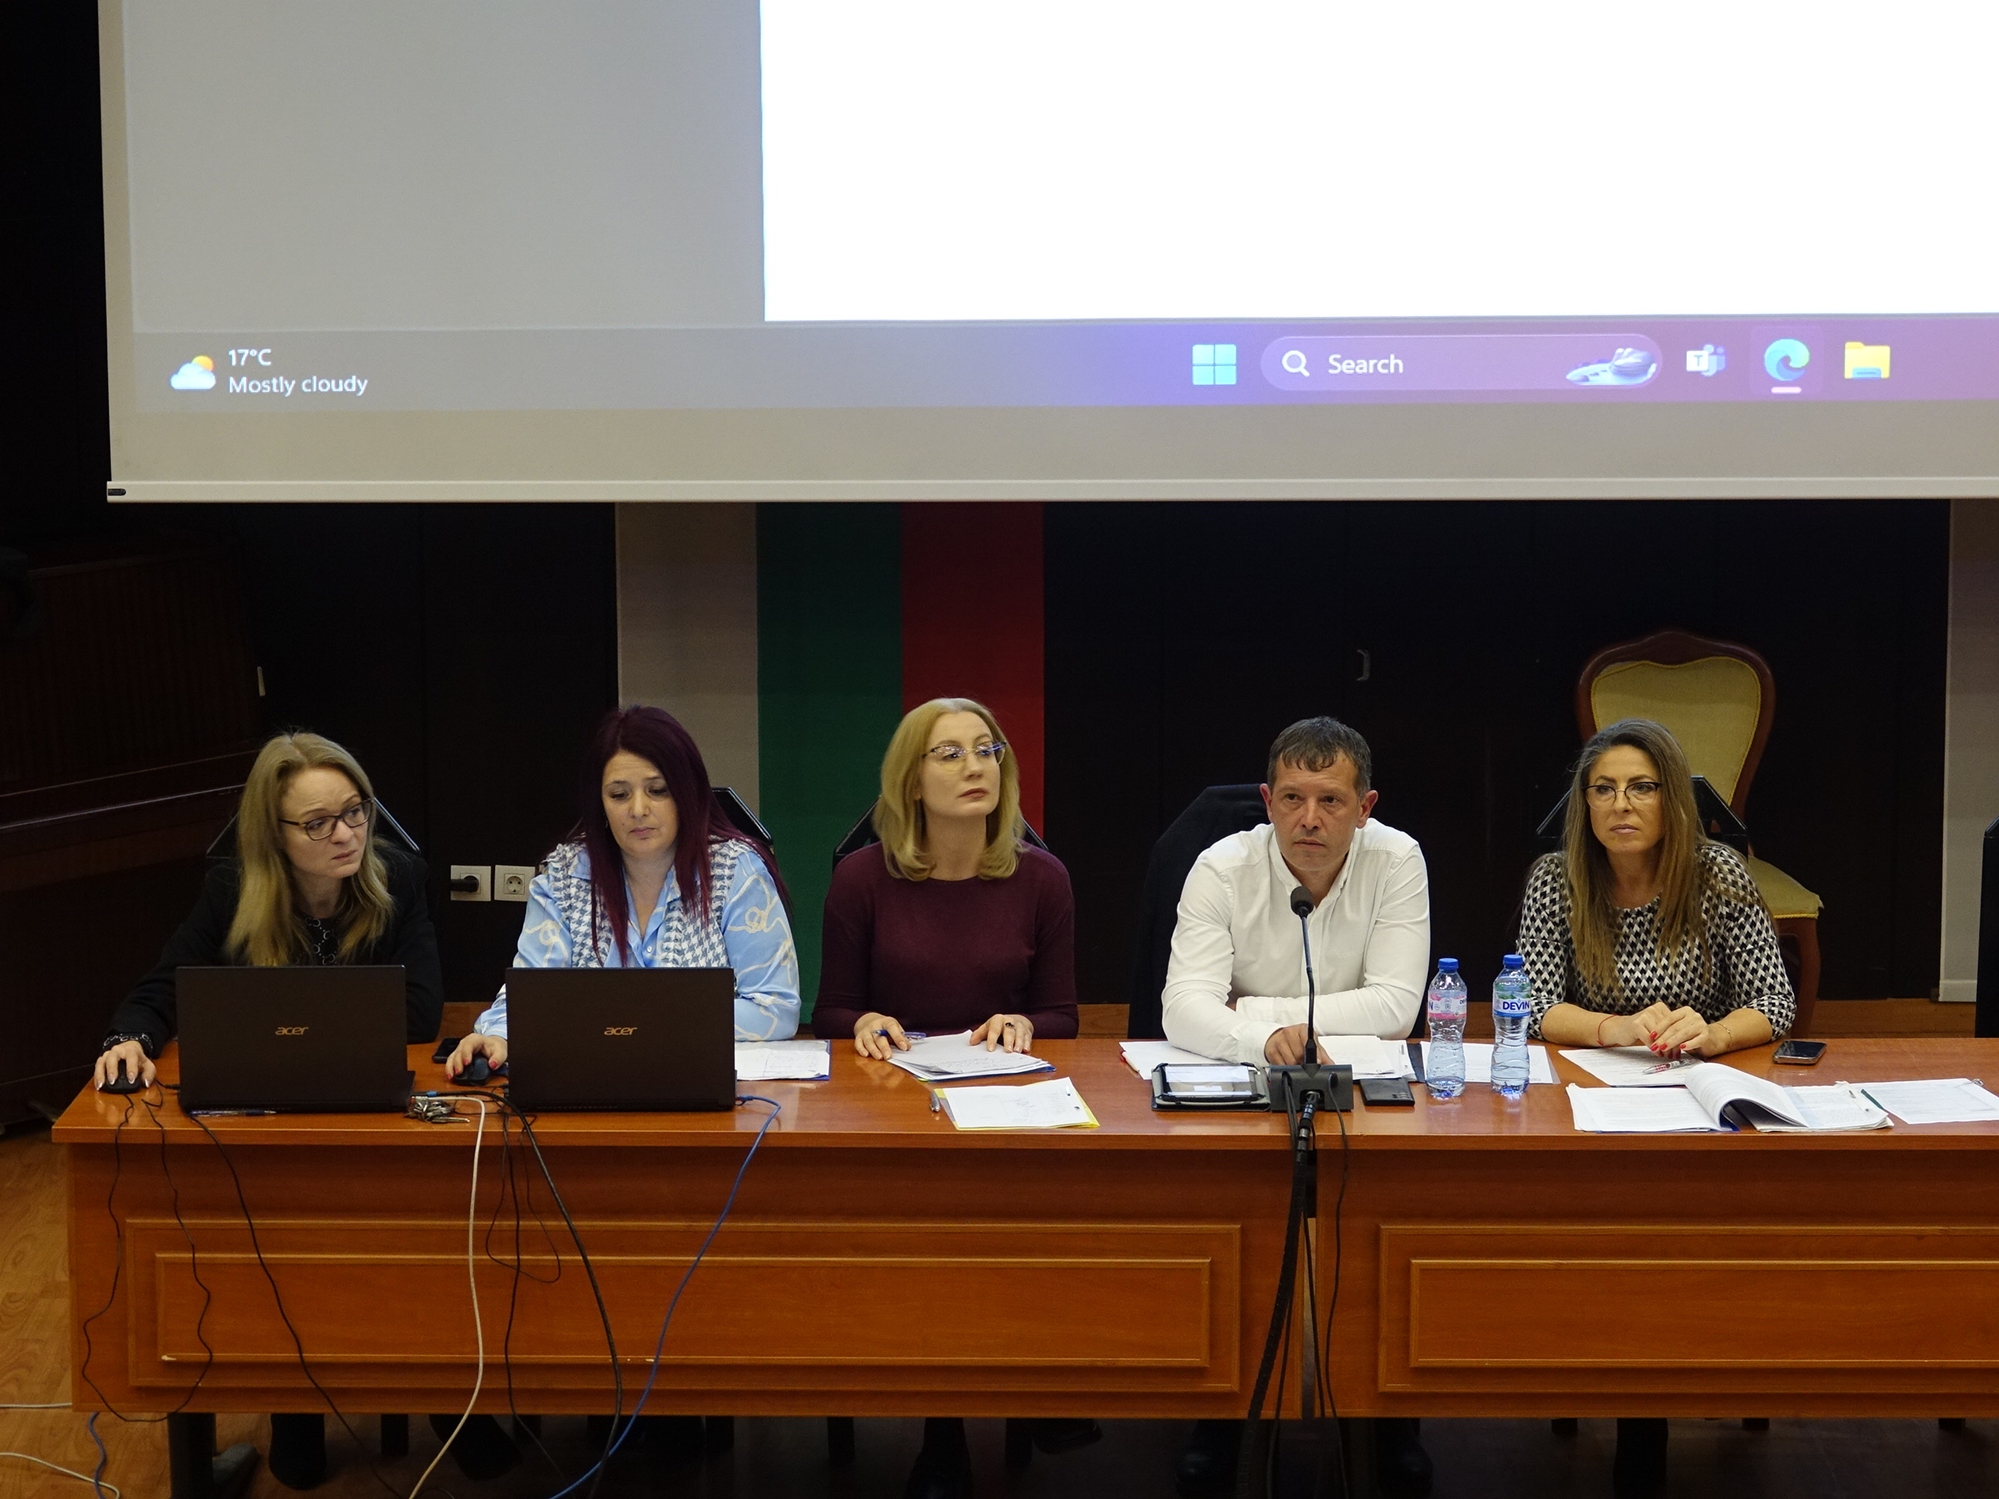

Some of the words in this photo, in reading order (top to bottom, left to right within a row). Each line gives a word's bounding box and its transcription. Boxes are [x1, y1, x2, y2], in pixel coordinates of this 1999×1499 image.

[228, 348, 272, 367] 17°C
[1328, 353, 1404, 374] Search
[228, 376, 296, 397] Mostly
[301, 375, 368, 397] cloudy
[1502, 1001, 1530, 1011] DEVIN
[275, 1026, 309, 1036] acer
[603, 1026, 638, 1036] acer
